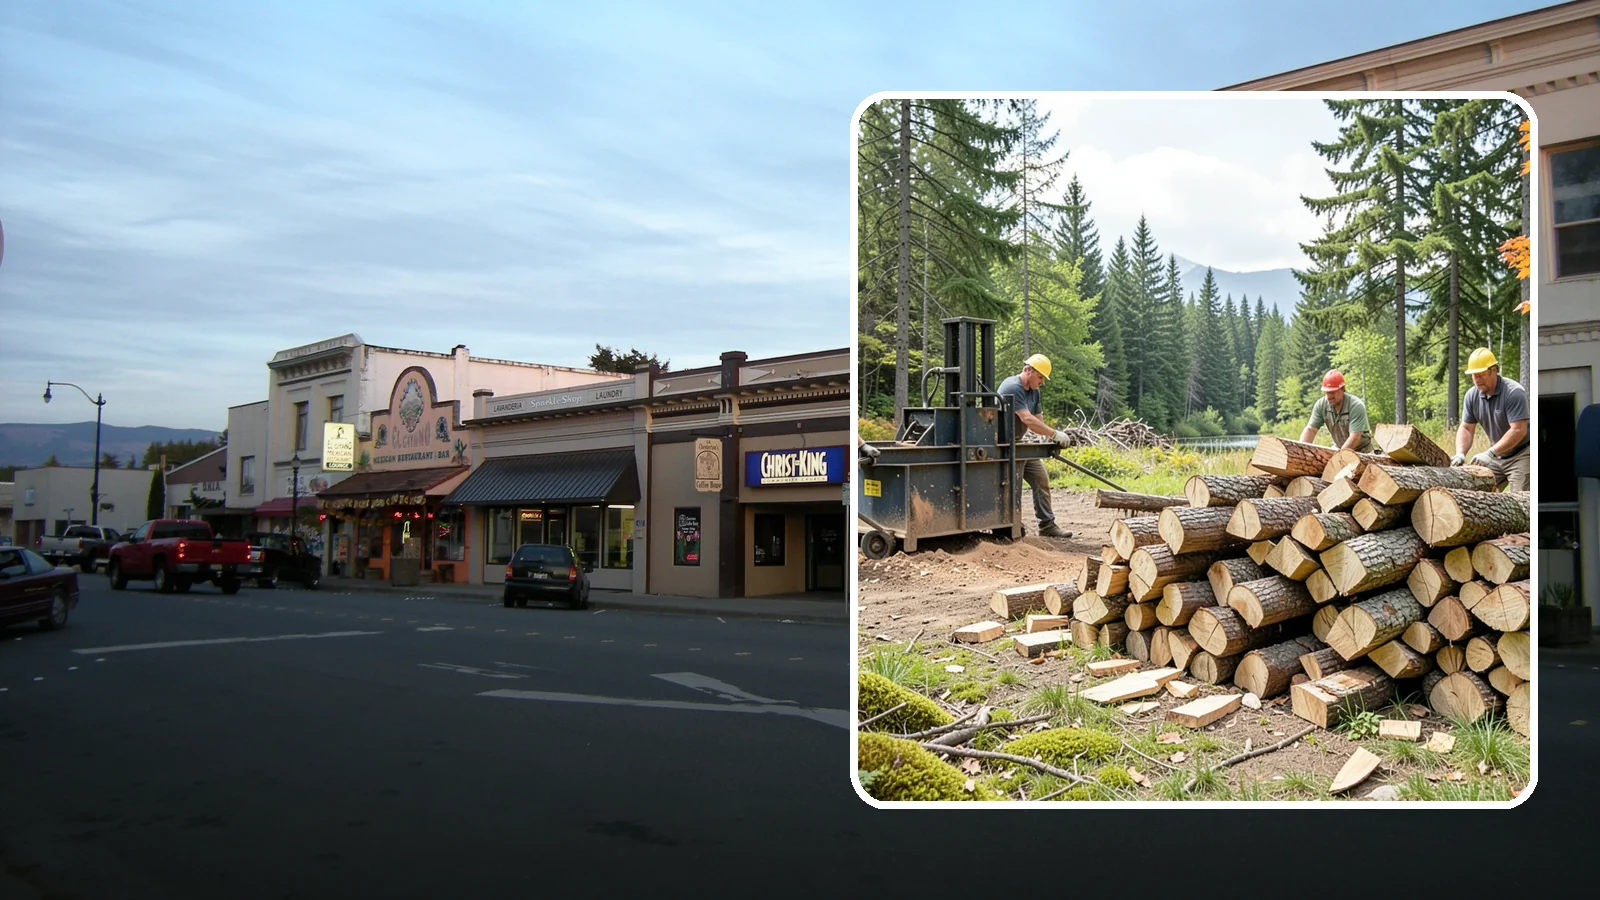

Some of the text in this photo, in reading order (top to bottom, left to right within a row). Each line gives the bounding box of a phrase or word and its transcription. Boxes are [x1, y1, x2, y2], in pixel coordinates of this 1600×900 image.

[493, 401, 523, 412] LAVANDERIA
[595, 388, 624, 400] LAUNDRY
[374, 450, 450, 464] MEXICAN RESTAURANT BAR
